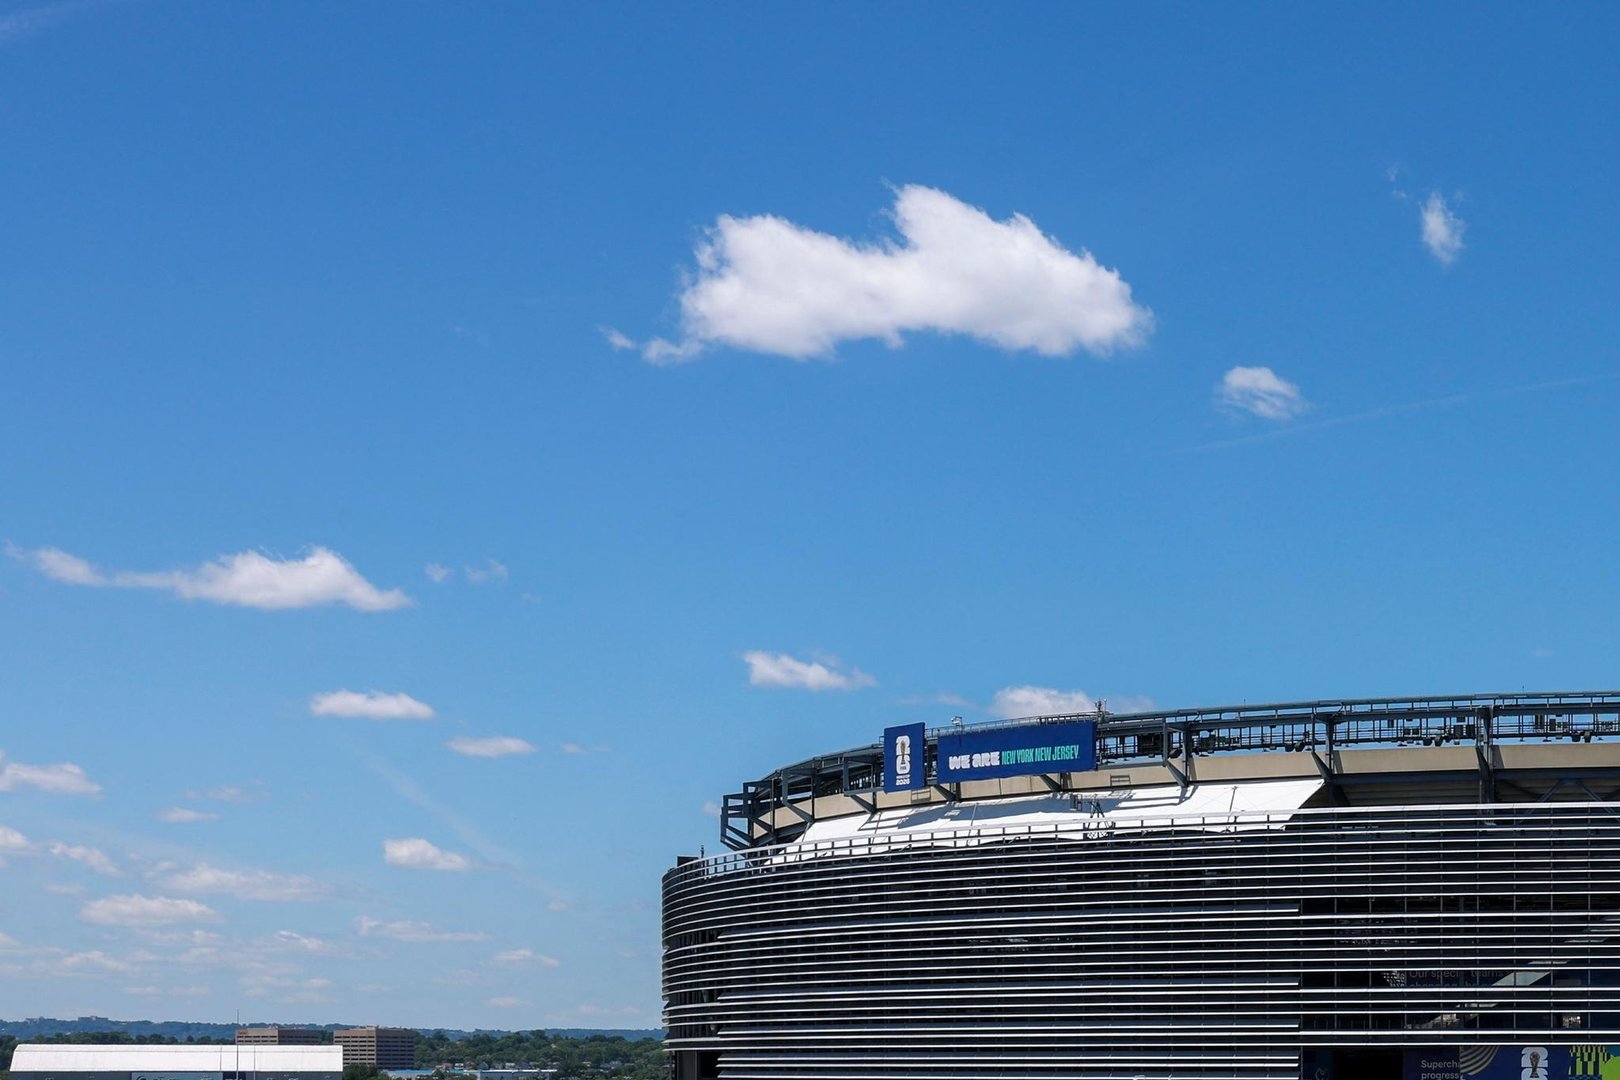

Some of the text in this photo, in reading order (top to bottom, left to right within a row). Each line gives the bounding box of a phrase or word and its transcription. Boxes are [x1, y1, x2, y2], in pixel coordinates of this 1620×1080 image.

[949, 745, 1079, 770] WE ARE NEW YORK NEW JERSEY
[1421, 1072, 1459, 1080] progress
